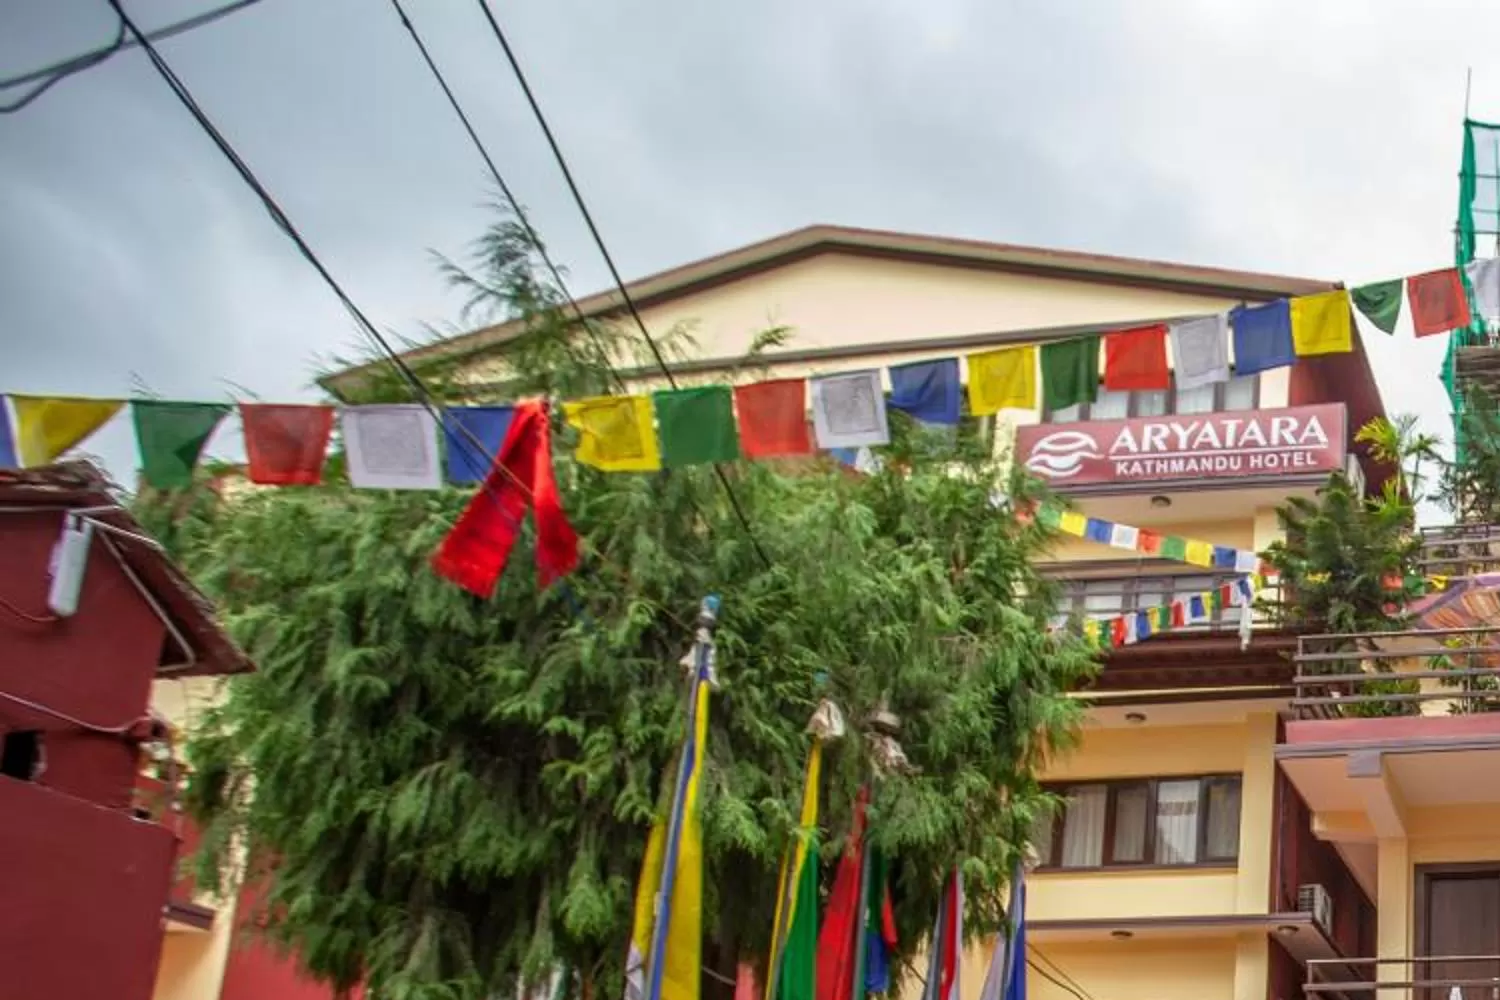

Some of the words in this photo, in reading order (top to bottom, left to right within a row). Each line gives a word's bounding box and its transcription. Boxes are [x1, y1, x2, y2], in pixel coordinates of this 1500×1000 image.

[1109, 415, 1329, 454] ARYATARA
[1115, 456, 1242, 476] KATHMANDU
[1249, 451, 1318, 469] HOTEL
